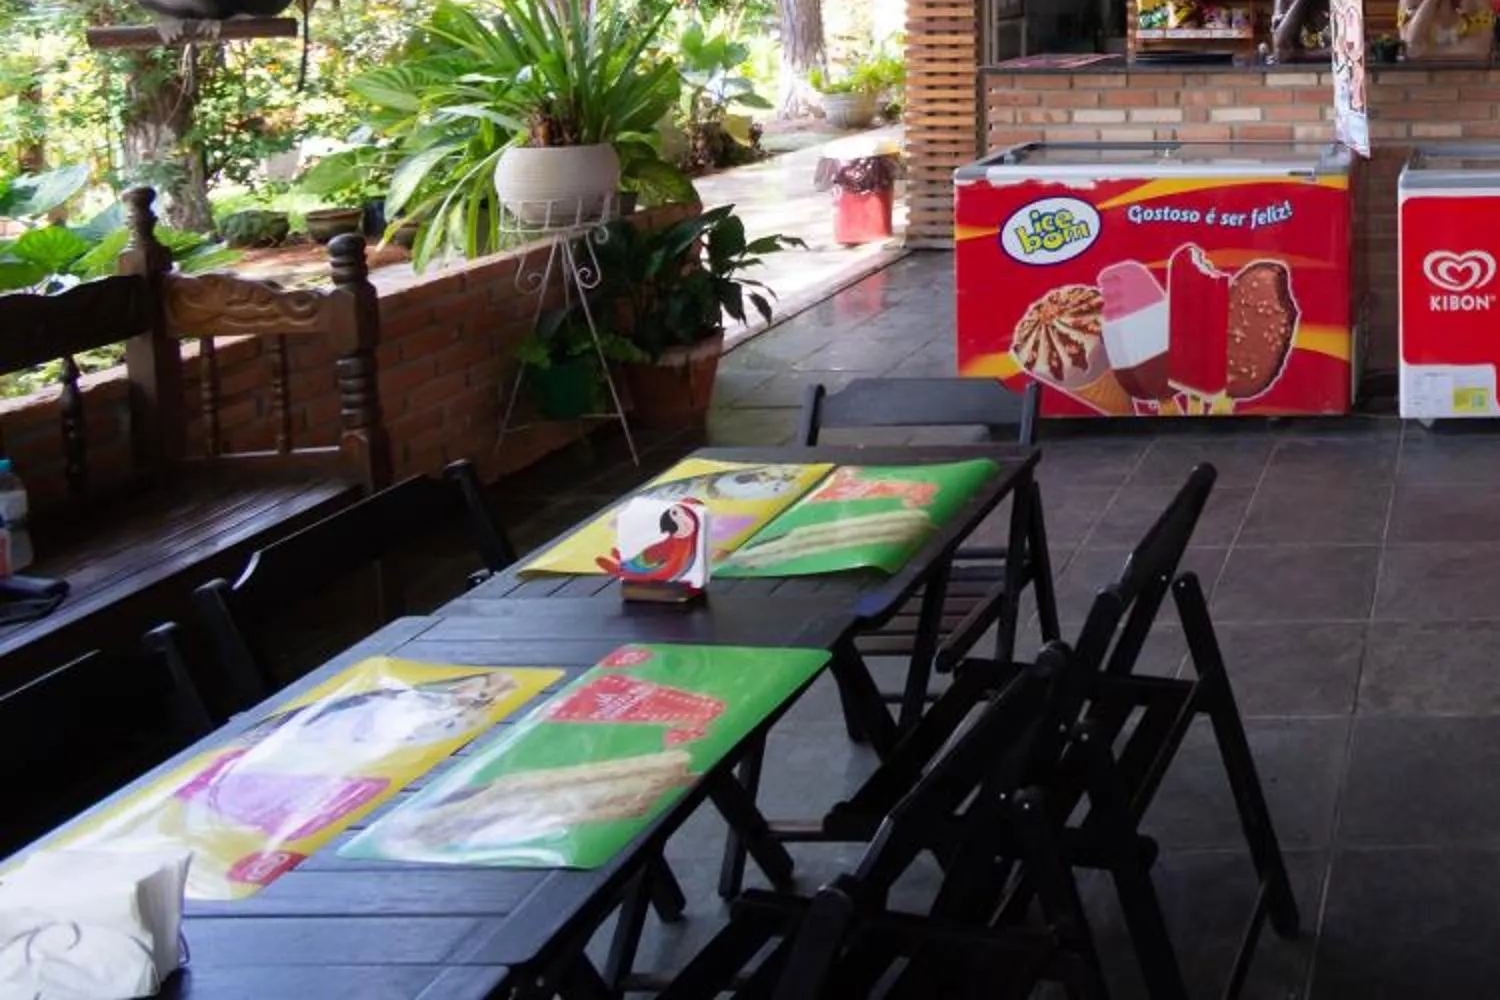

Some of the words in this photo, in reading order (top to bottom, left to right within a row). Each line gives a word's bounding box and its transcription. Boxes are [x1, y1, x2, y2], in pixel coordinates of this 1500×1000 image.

[1029, 209, 1074, 234] ice
[1127, 204, 1201, 225] Gostoso
[1205, 207, 1217, 225] é
[1219, 212, 1247, 227] ser
[1429, 294, 1490, 312] KIBON
